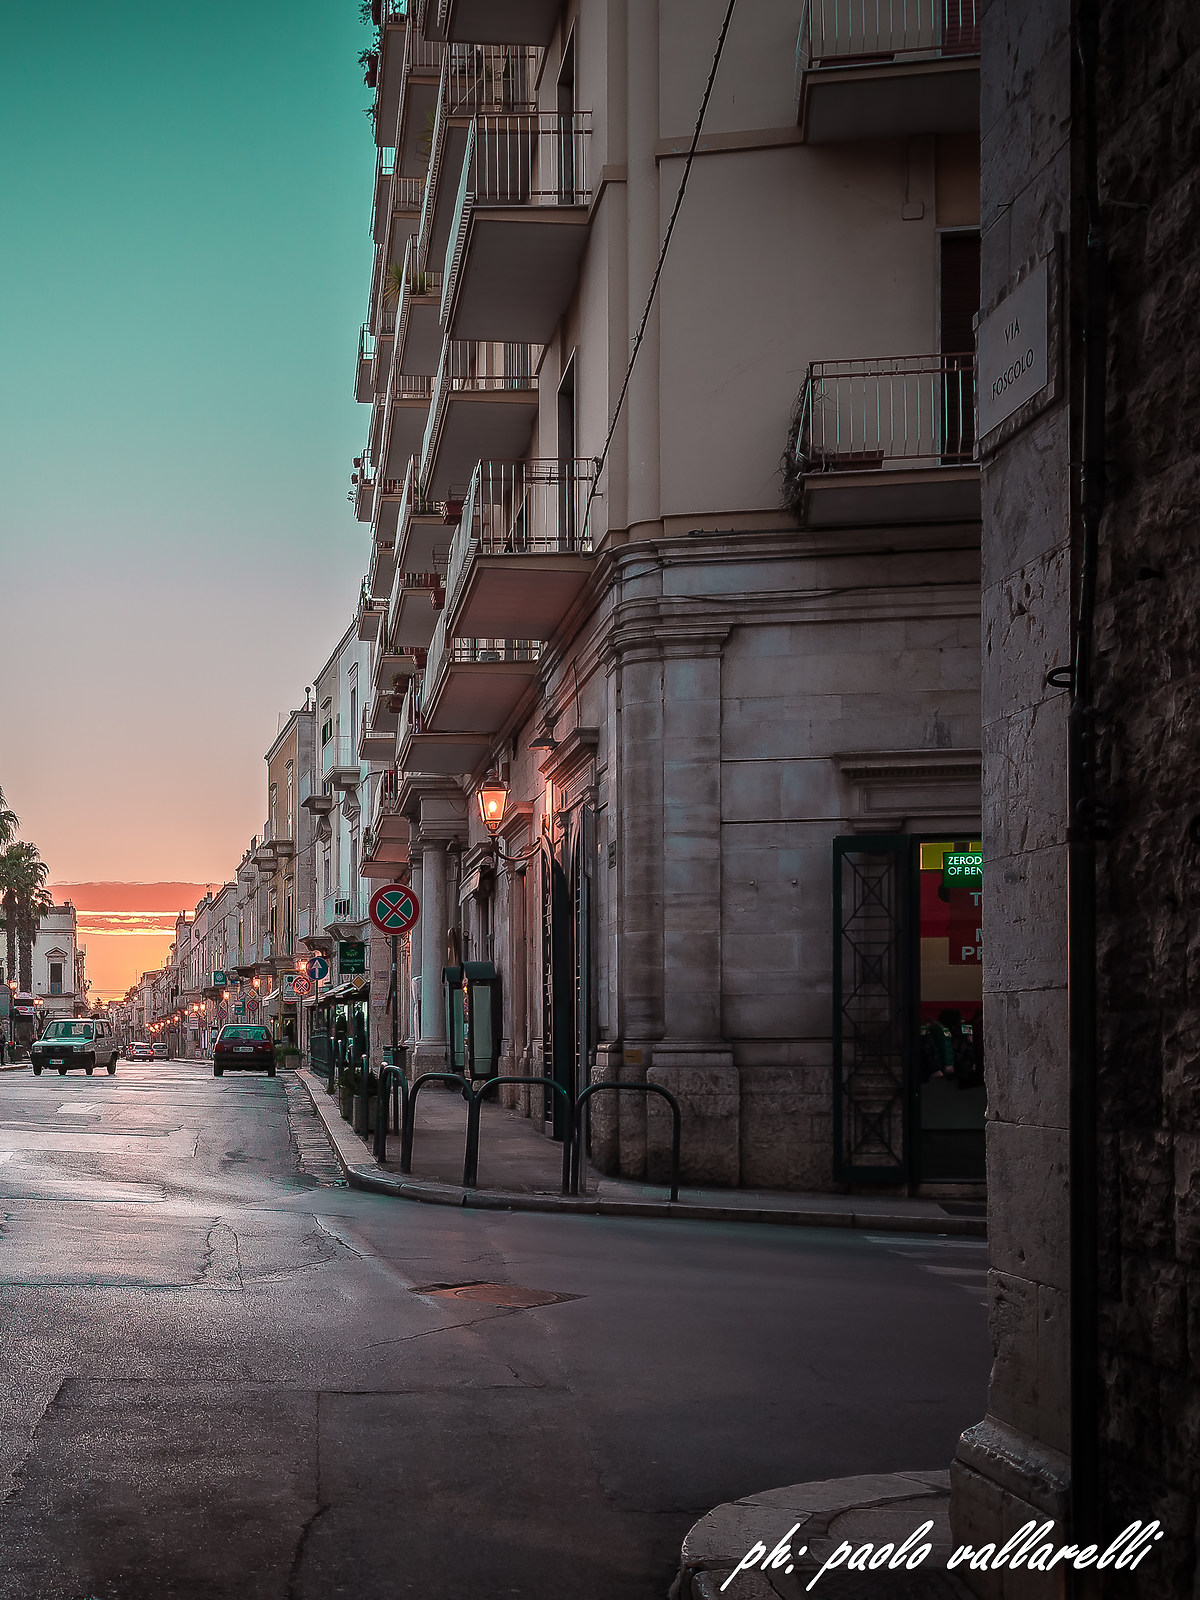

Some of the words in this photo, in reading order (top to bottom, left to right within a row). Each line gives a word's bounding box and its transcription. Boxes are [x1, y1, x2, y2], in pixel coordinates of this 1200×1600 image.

[1003, 316, 1021, 344] VIA
[991, 347, 1034, 401] FOSCOLO
[947, 866, 962, 875] OF
